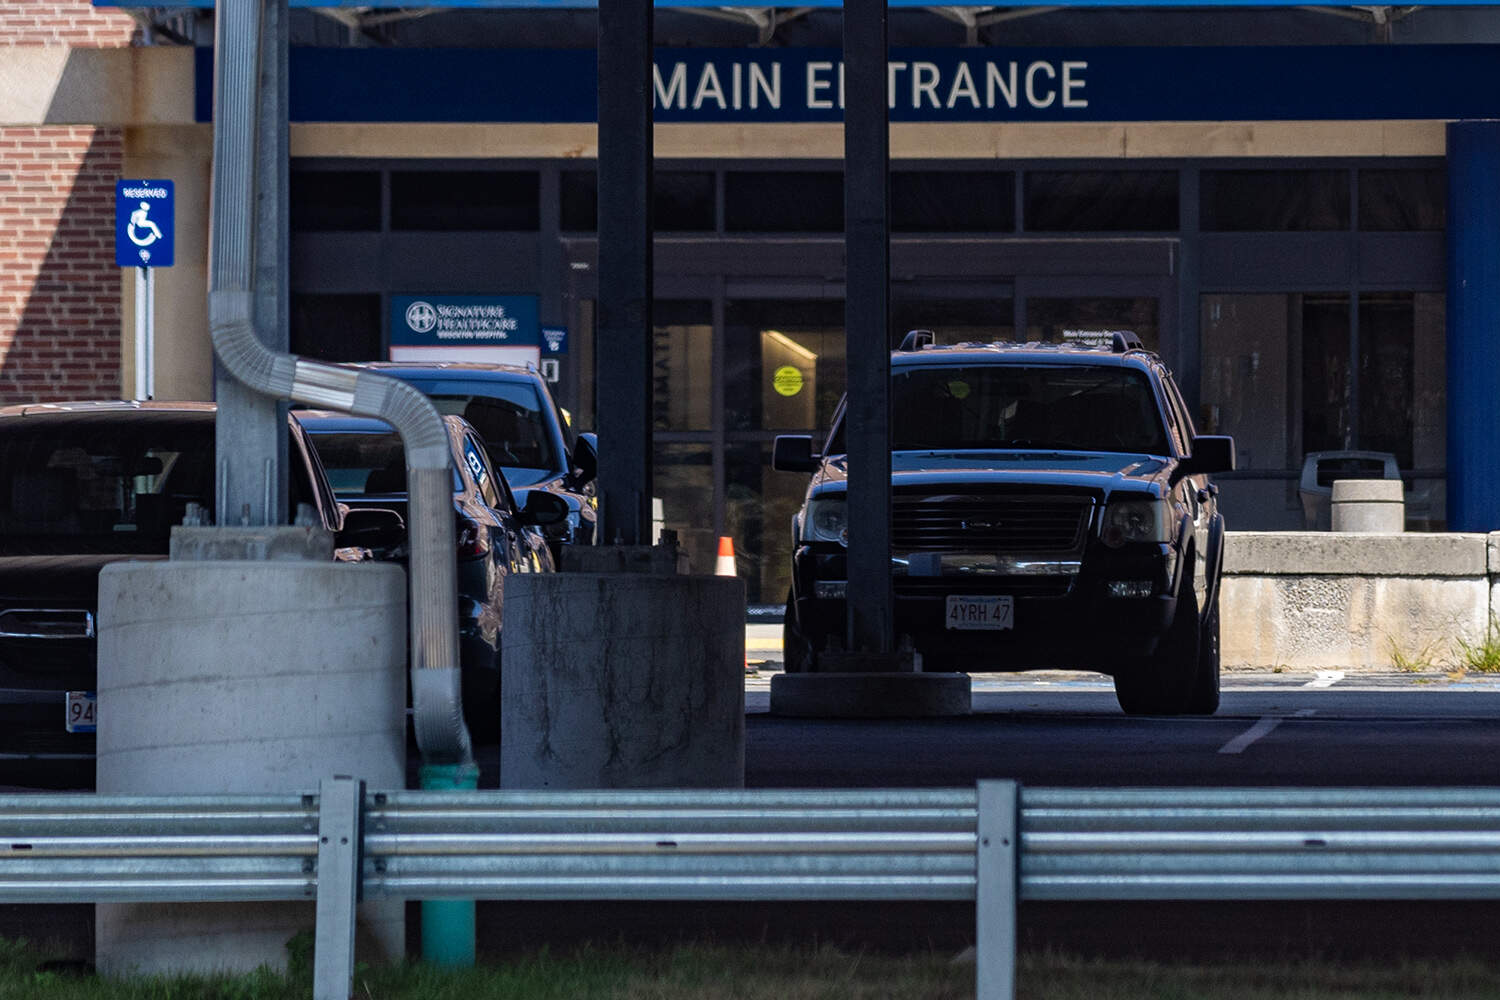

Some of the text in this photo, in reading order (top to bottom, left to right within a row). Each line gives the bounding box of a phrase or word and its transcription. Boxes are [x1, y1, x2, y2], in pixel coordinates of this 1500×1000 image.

[653, 61, 1089, 110] MAIN ETRANCE
[123, 188, 168, 198] RESERVED
[436, 304, 505, 318] SIGNATURE
[436, 318, 519, 331] HEALTHCARE
[950, 604, 1010, 621] 4YRH 47
[72, 702, 97, 722] 94
